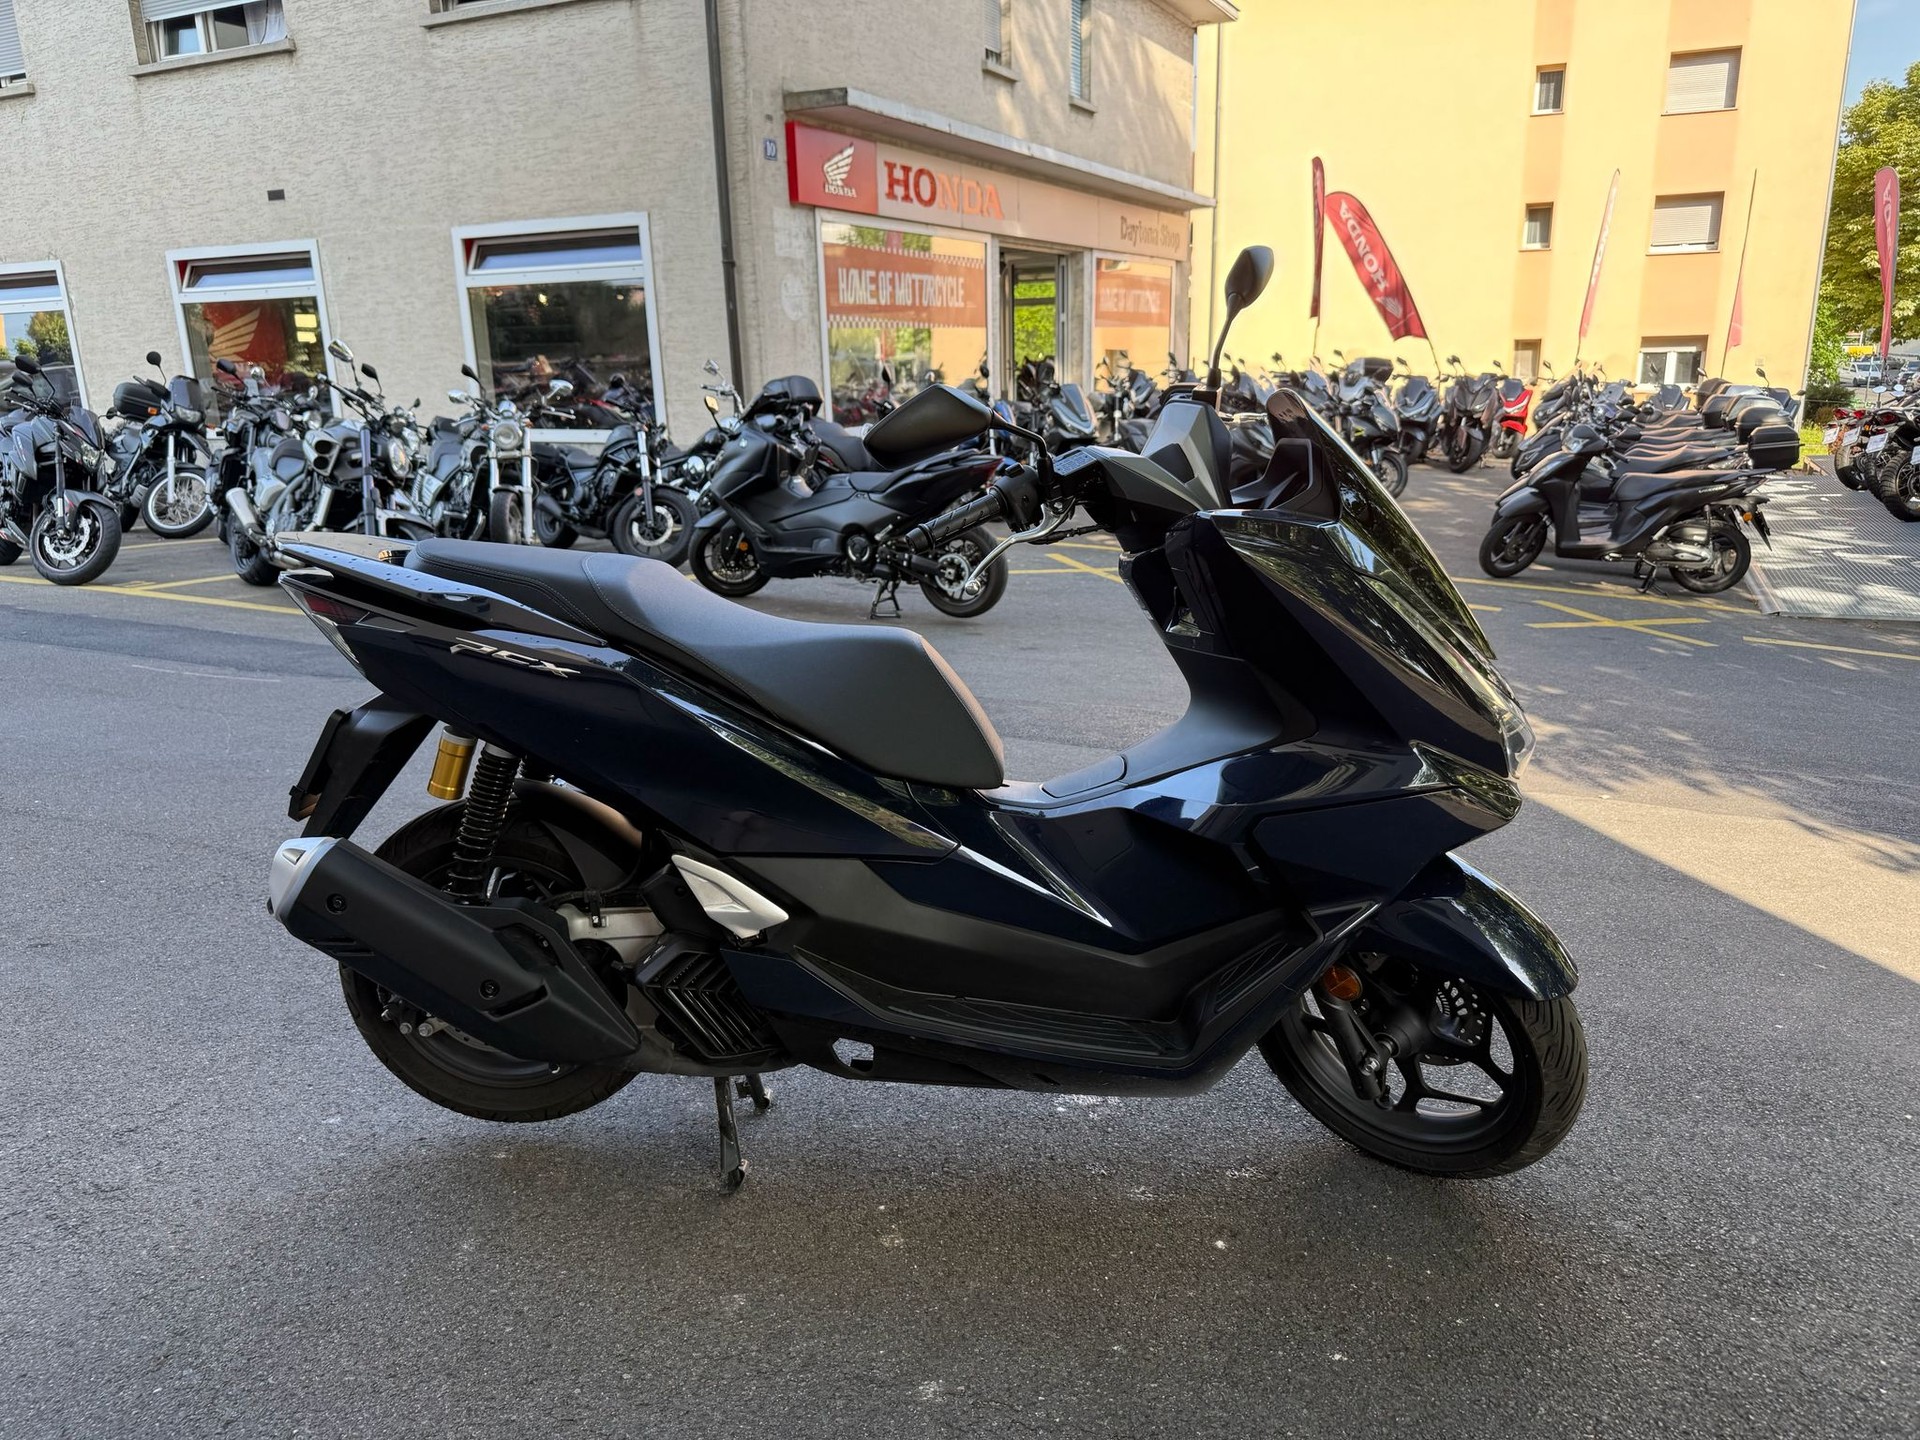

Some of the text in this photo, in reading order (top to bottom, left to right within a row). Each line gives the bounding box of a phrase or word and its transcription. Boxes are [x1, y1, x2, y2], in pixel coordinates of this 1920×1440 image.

[884, 161, 1005, 220] HONDA
[1339, 199, 1389, 293] HONDA
[838, 267, 877, 304] HOME
[878, 270, 893, 305] OF
[450, 637, 581, 678] PCX
